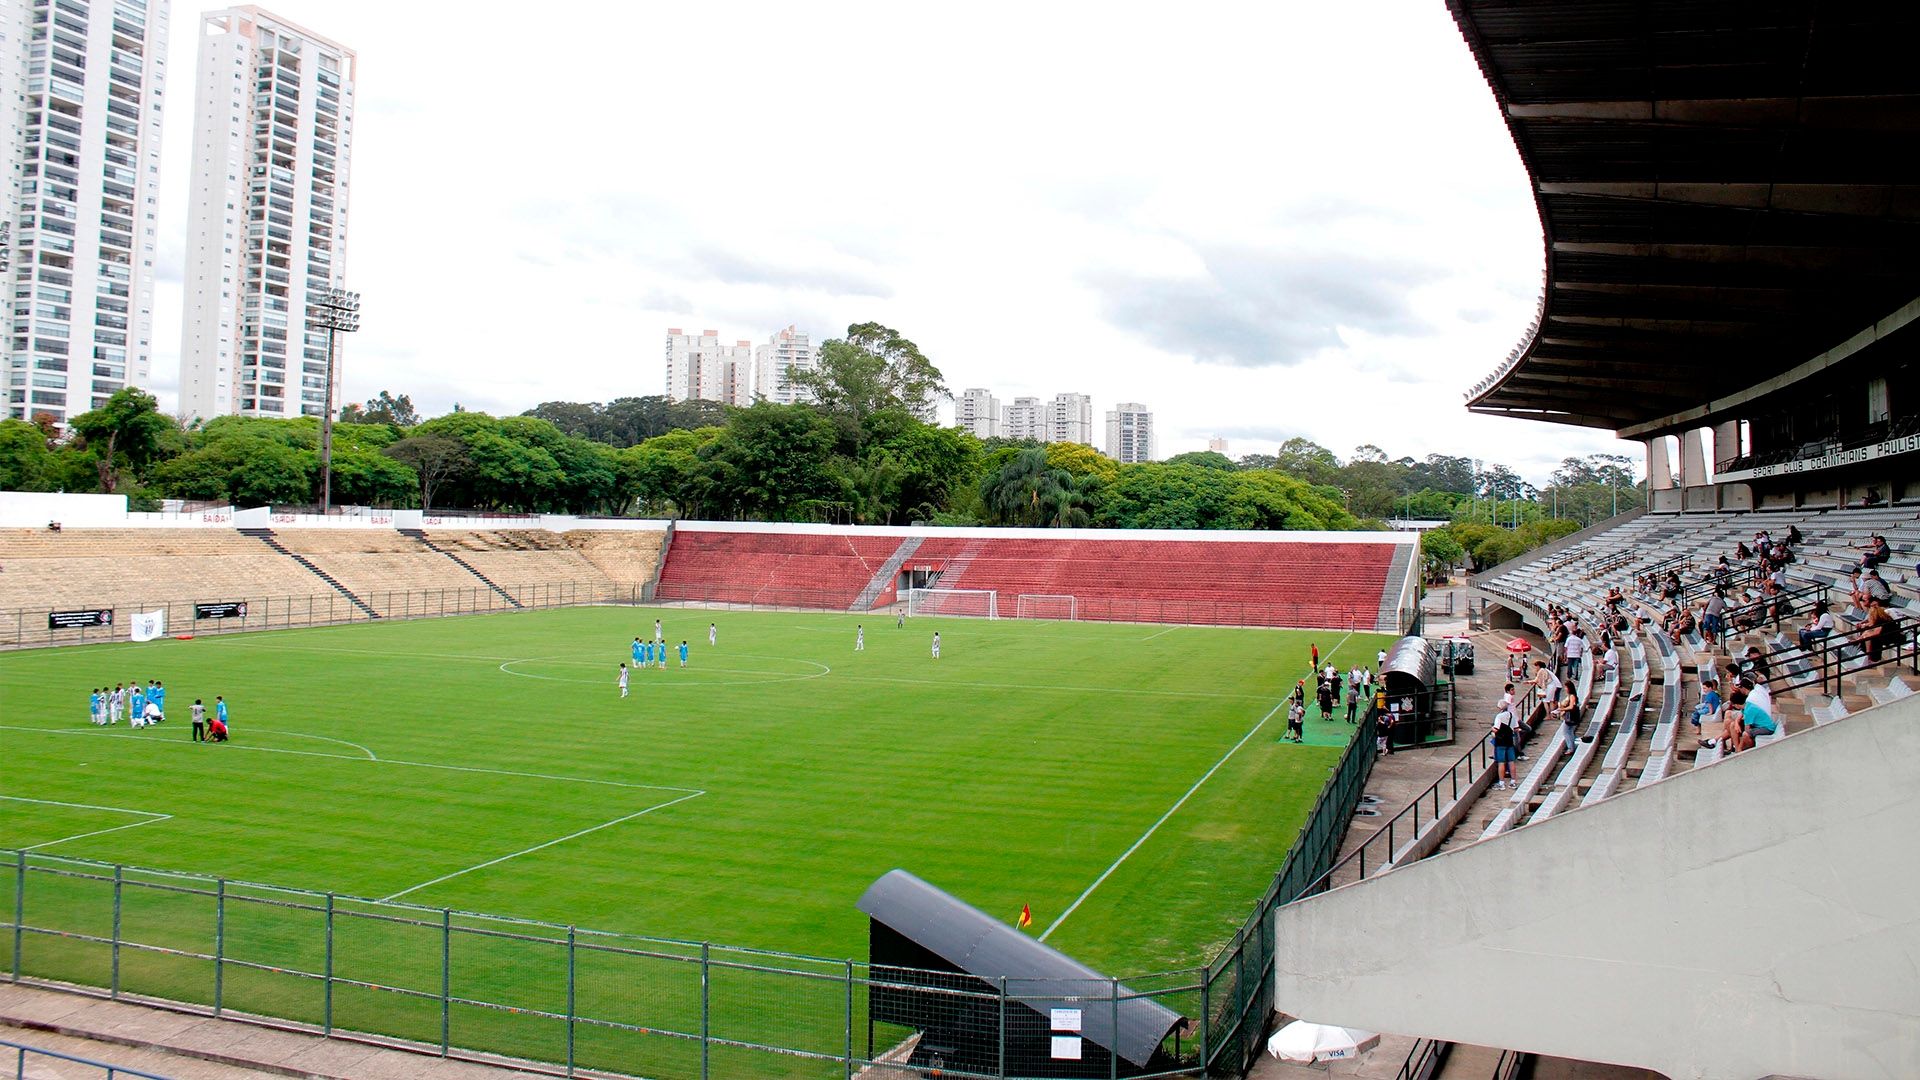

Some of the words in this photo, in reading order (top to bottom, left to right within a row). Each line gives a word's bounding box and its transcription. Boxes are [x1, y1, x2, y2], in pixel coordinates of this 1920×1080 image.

[1752, 465, 1776, 478] SPORT
[1783, 461, 1804, 473] CLUB
[1810, 447, 1868, 470] CORINTHIANS
[1328, 1049, 1345, 1057] VISA
